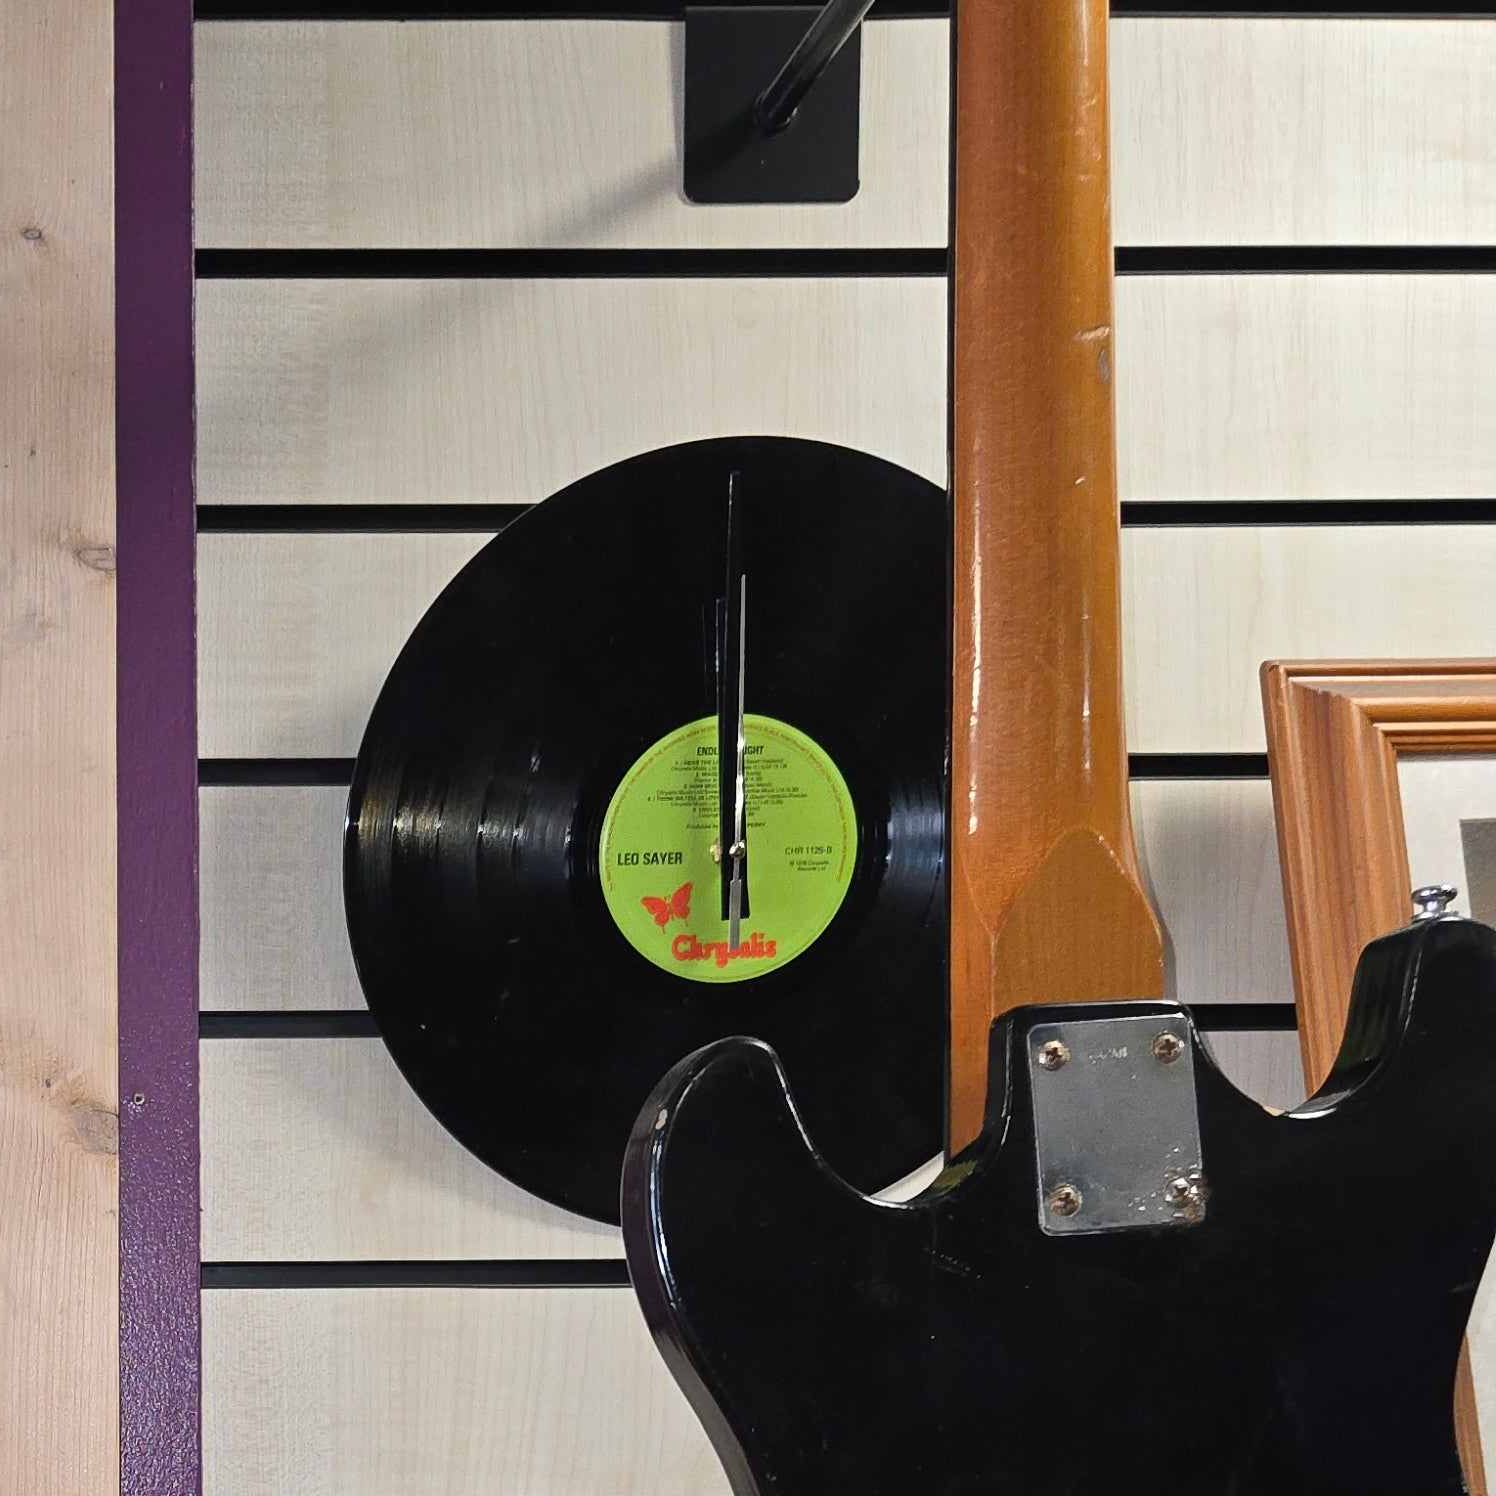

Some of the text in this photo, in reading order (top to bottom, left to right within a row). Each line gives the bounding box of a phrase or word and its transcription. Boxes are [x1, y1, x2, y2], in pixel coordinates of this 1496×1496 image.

[696, 745, 719, 757] ENDL
[784, 847, 803, 856] CHR
[617, 851, 683, 866] LEO SAYER
